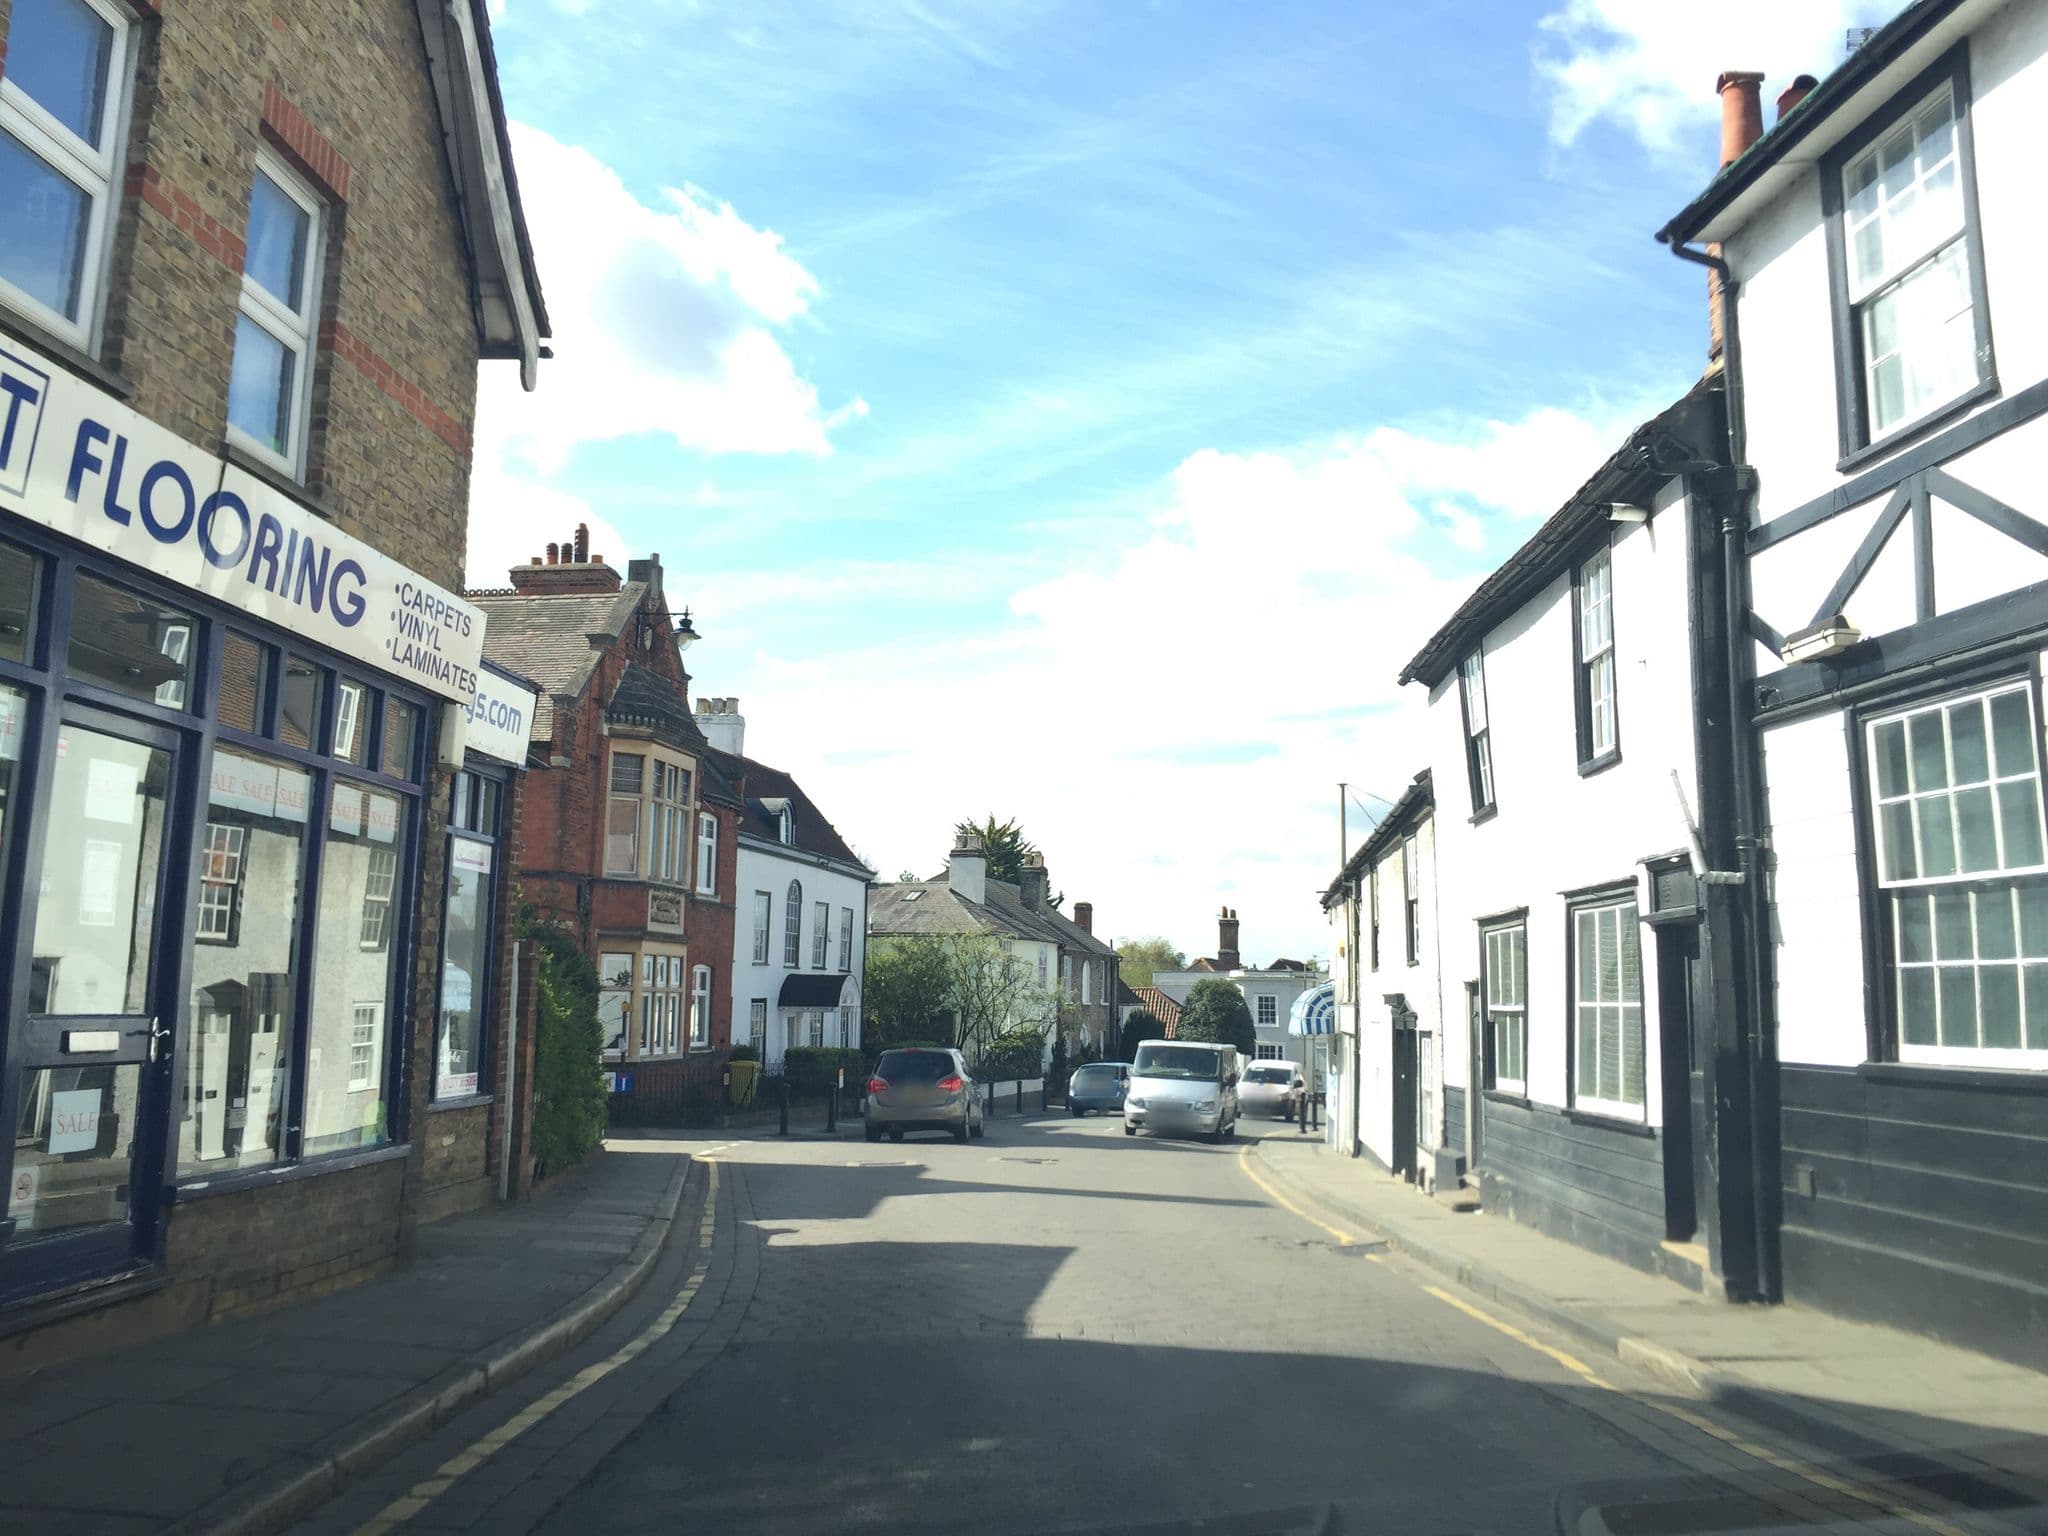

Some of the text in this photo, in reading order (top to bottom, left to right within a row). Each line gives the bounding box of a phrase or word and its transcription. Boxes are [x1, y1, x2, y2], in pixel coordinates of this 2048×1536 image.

[64, 418, 367, 627] FLOORING
[399, 608, 441, 652] VINYL
[401, 582, 472, 638] CARPETS
[391, 637, 477, 695] LAMINATES
[465, 687, 522, 735] gs.com
[213, 772, 273, 801] ALE SALE
[278, 787, 306, 809] SALE
[56, 1112, 97, 1135] SALE
